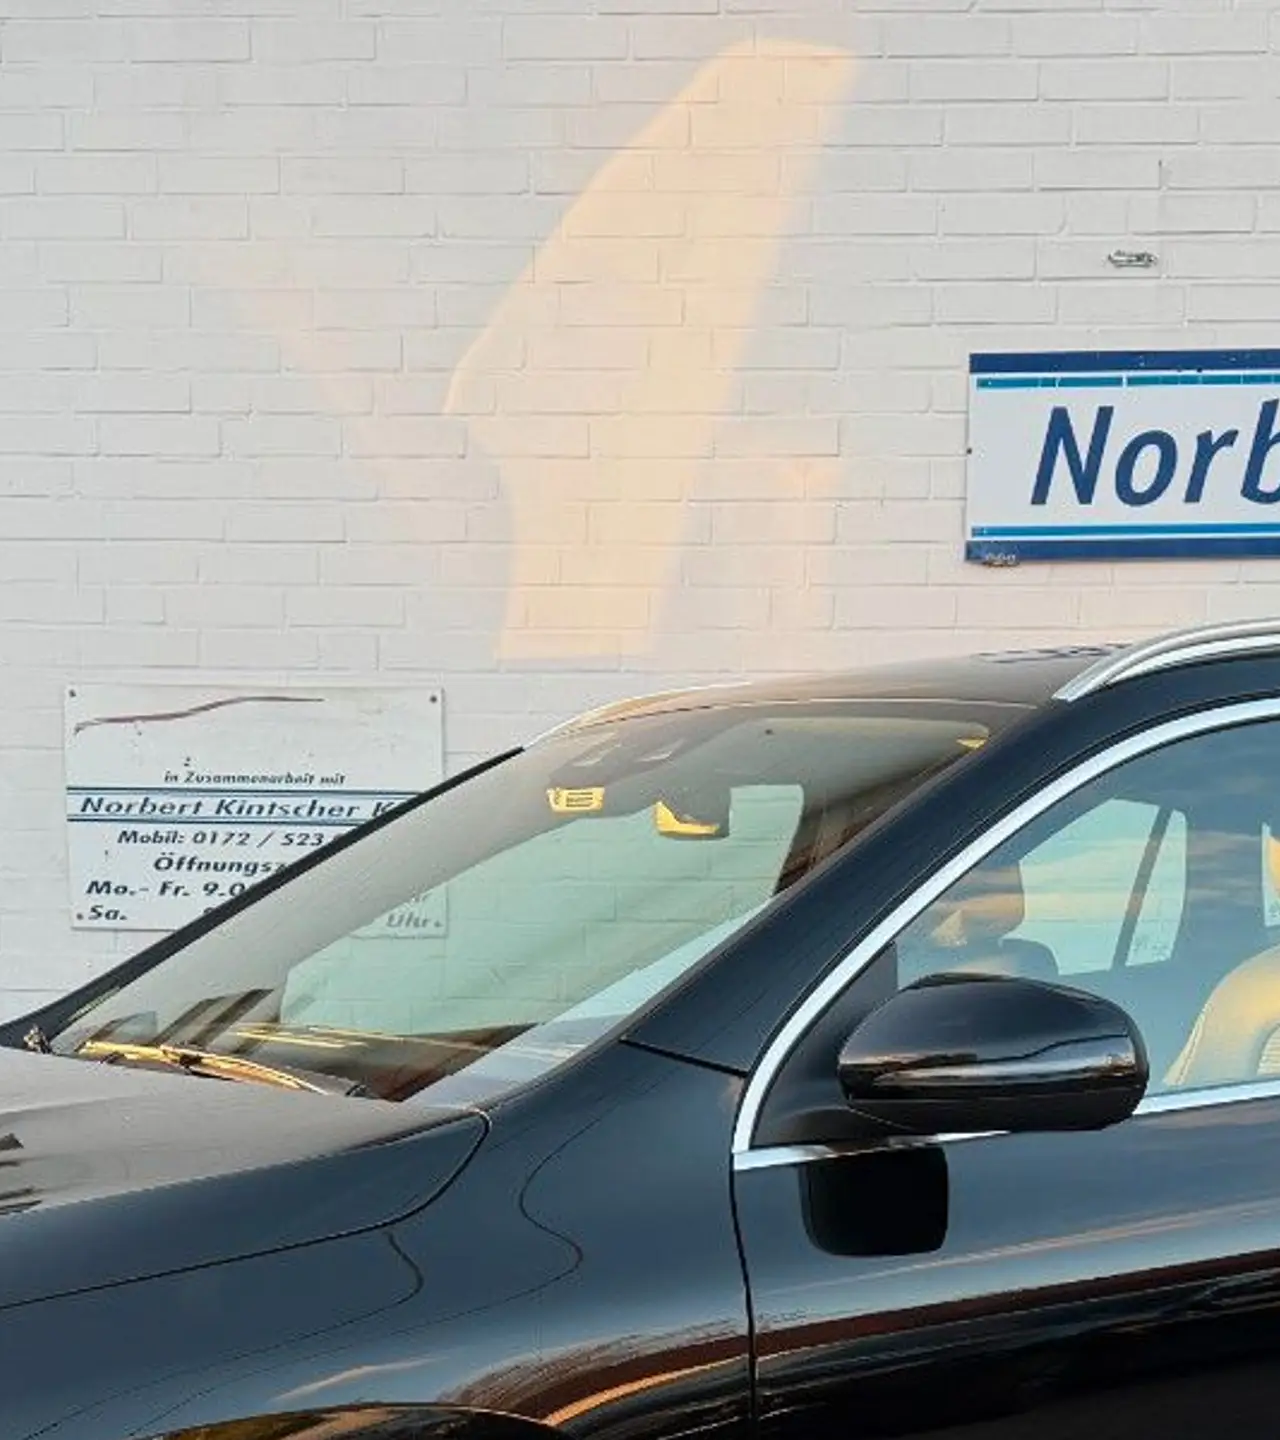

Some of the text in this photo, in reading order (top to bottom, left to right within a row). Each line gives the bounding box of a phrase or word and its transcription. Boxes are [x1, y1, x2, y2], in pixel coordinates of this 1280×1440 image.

[163, 770, 346, 785] in Zusammenarbeit mit
[80, 796, 203, 815] Norbert
[215, 799, 361, 818] Kintscher
[117, 829, 185, 845] Mobil:
[192, 831, 251, 846] 0172
[280, 833, 324, 846] 523
[159, 881, 190, 897] Fr.
[203, 881, 246, 897] 9.0
[87, 904, 128, 921] Sa.
